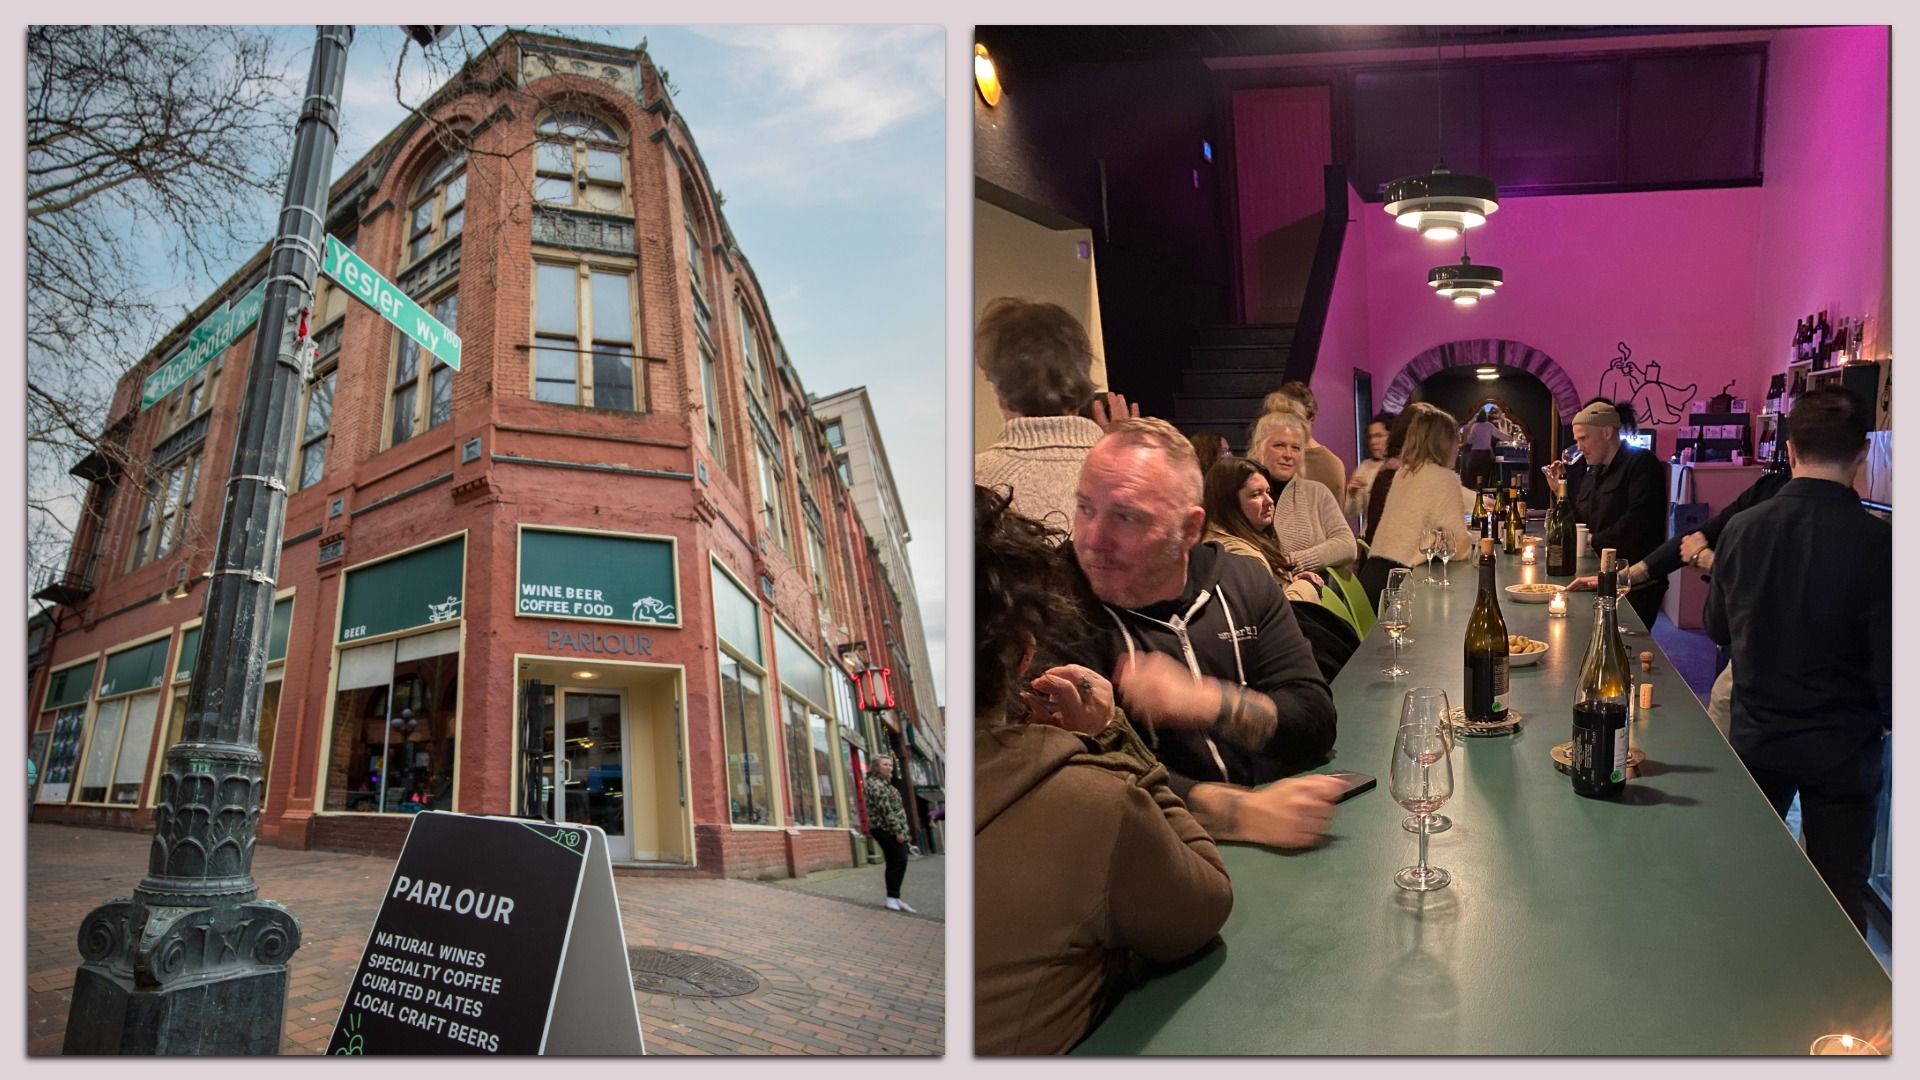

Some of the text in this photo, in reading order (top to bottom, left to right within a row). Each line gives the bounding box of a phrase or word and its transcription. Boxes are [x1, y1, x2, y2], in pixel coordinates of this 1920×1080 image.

[334, 243, 458, 350] Yesler Wy 100
[160, 301, 260, 391] Occidental Ave
[573, 602, 614, 617] FOOD
[344, 625, 366, 640] BEER
[546, 629, 653, 656] PARLOUR
[392, 875, 515, 925] PARLOUR
[375, 931, 487, 968] NATURAL WINES
[361, 972, 484, 1018] CURATED PLATES
[368, 953, 502, 995] SPECIALTY COFFEE
[353, 991, 500, 1053] LOCAL CRAFT BEERS
